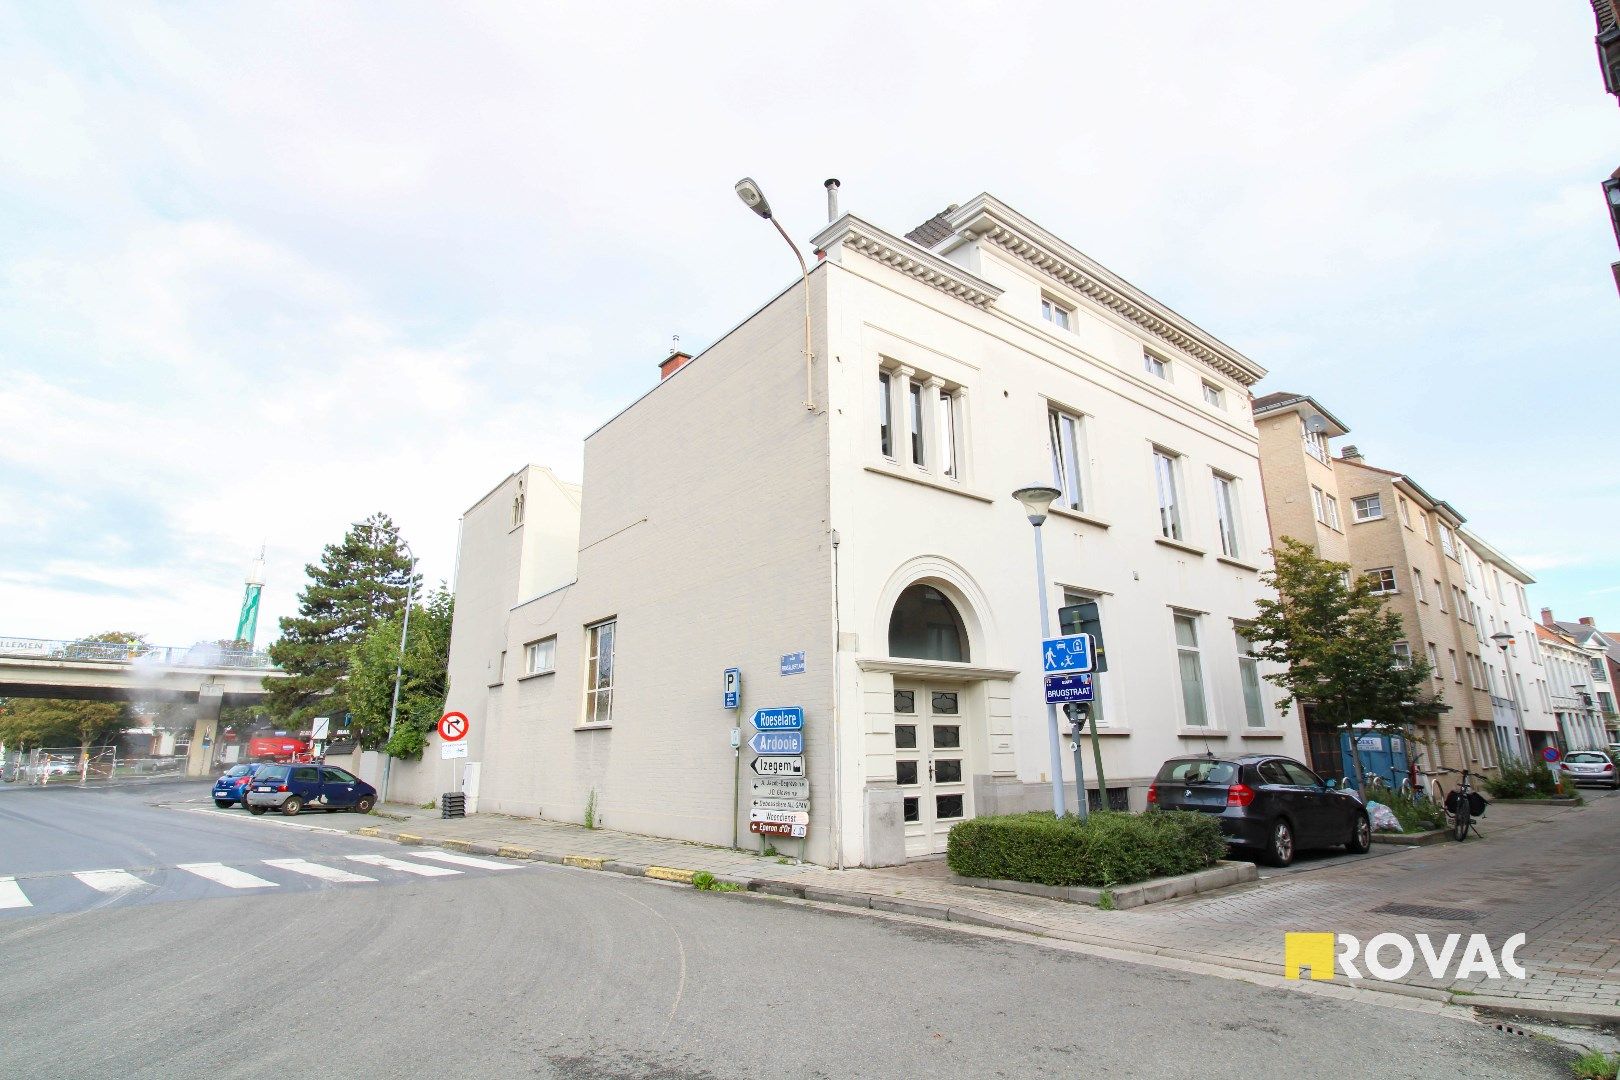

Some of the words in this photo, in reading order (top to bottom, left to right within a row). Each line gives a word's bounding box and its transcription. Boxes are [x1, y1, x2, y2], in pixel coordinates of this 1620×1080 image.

[728, 674, 734, 691] P
[1047, 687, 1090, 698] BRUGSTRAAT
[760, 710, 796, 726] Roeselare
[760, 735, 797, 750] Ardooie
[760, 758, 791, 773] Izegem
[759, 822, 778, 832] Eperon
